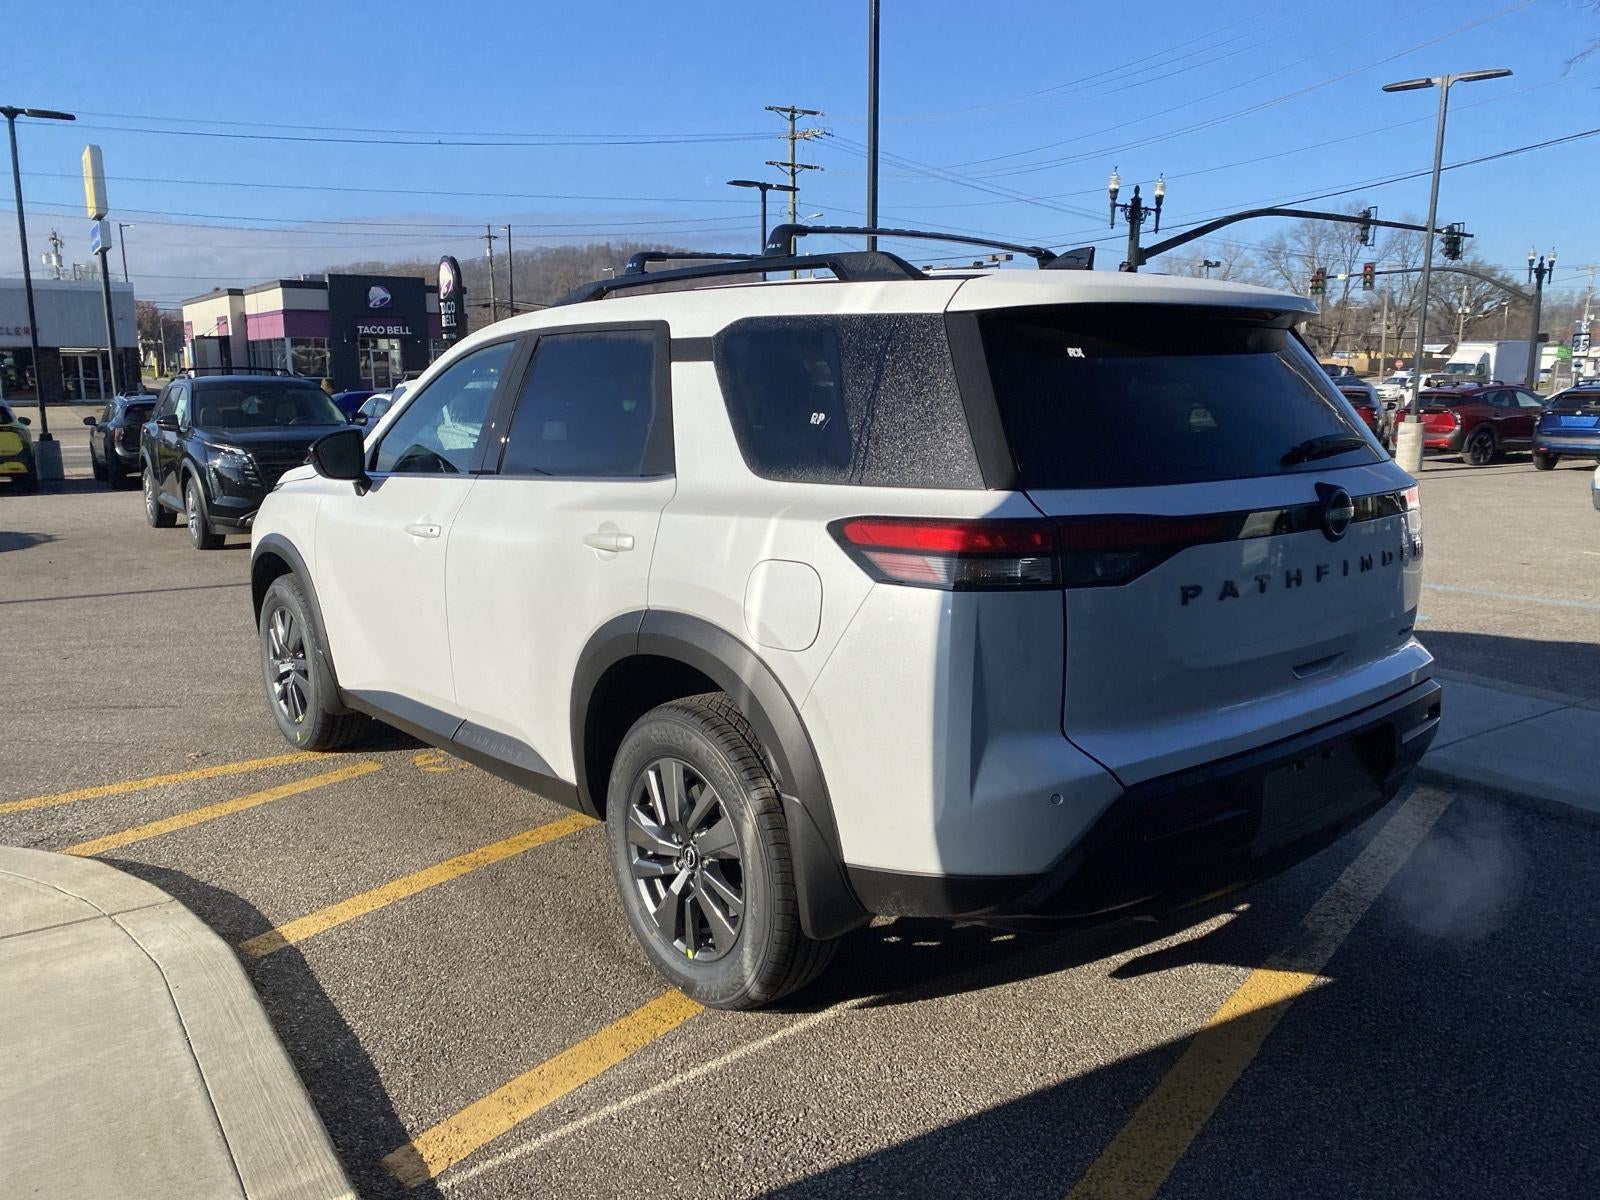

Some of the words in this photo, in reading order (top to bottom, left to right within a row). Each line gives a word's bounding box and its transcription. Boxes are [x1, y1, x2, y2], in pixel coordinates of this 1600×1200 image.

[357, 325, 385, 334] TACO
[387, 325, 412, 335] BELL
[1573, 338, 1589, 352] 25
